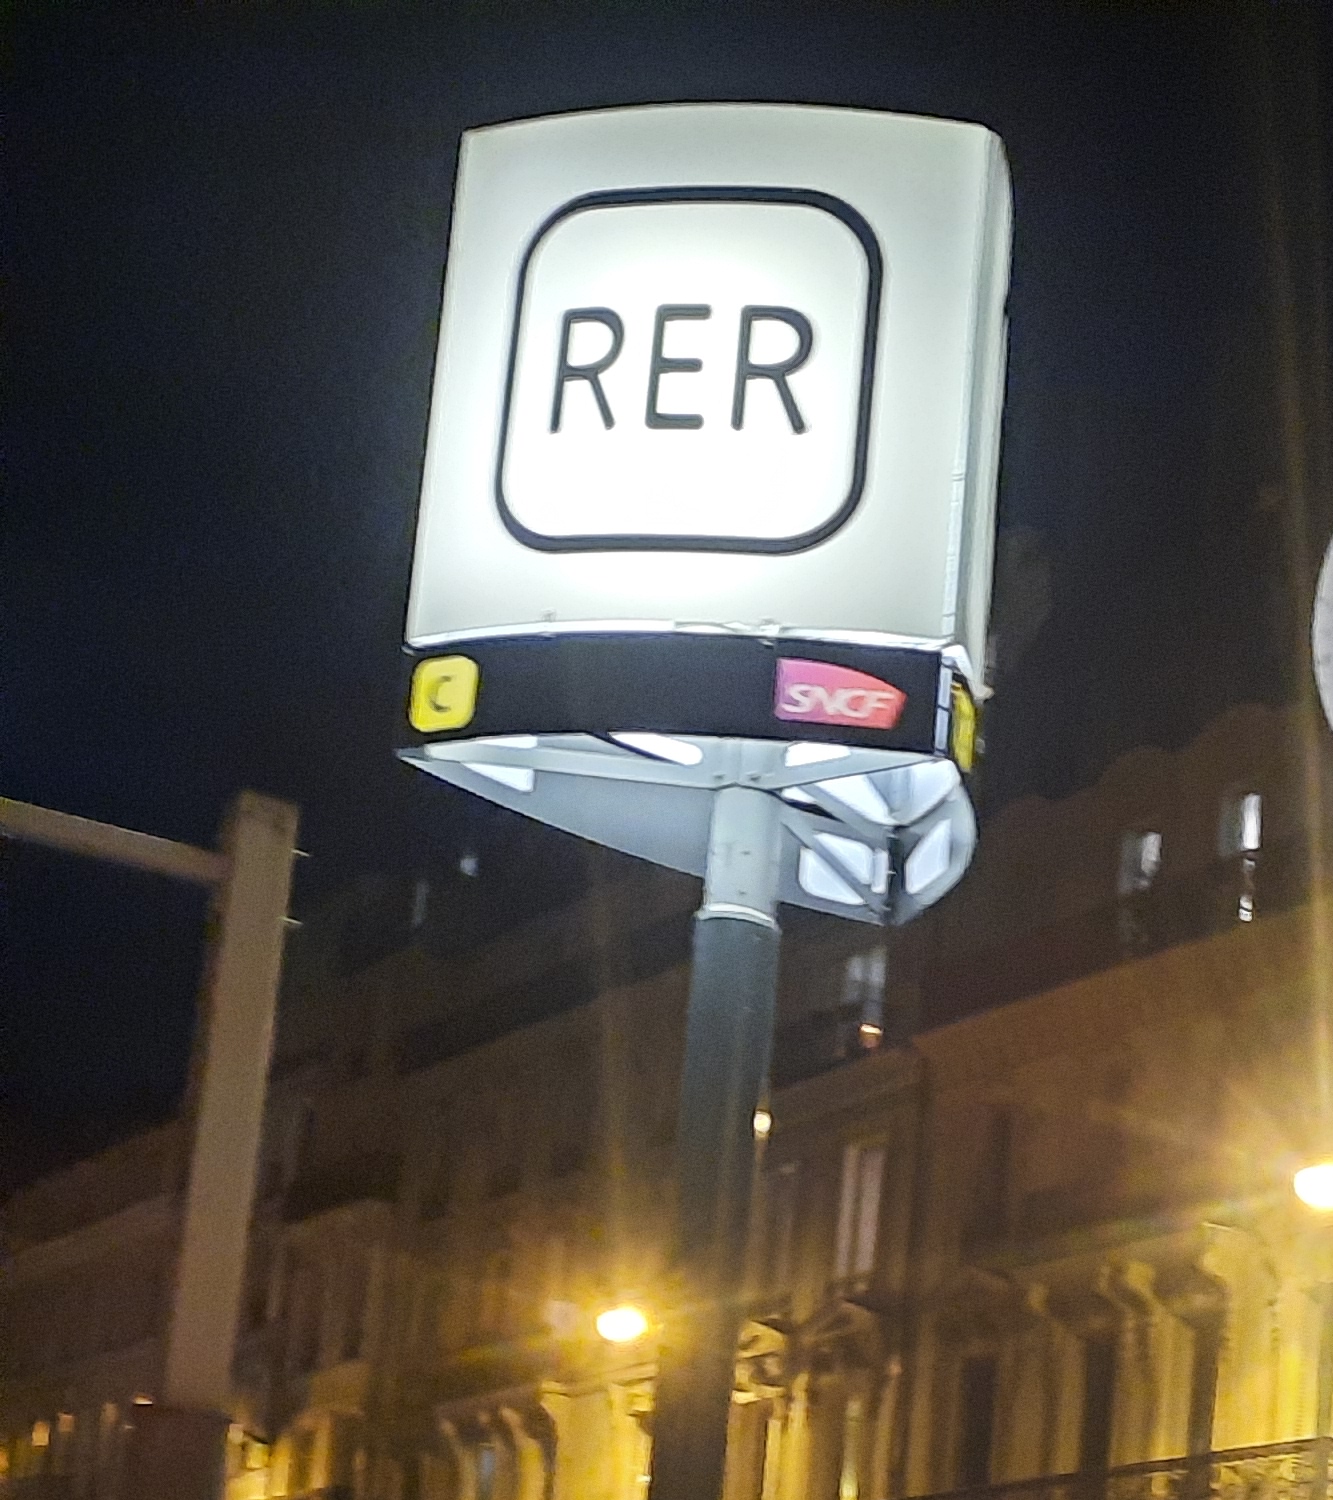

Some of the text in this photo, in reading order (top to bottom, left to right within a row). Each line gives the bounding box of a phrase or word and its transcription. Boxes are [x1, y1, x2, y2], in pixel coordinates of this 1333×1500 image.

[548, 303, 814, 435] RER
[429, 674, 453, 714] C
[781, 682, 896, 719] SNCF
